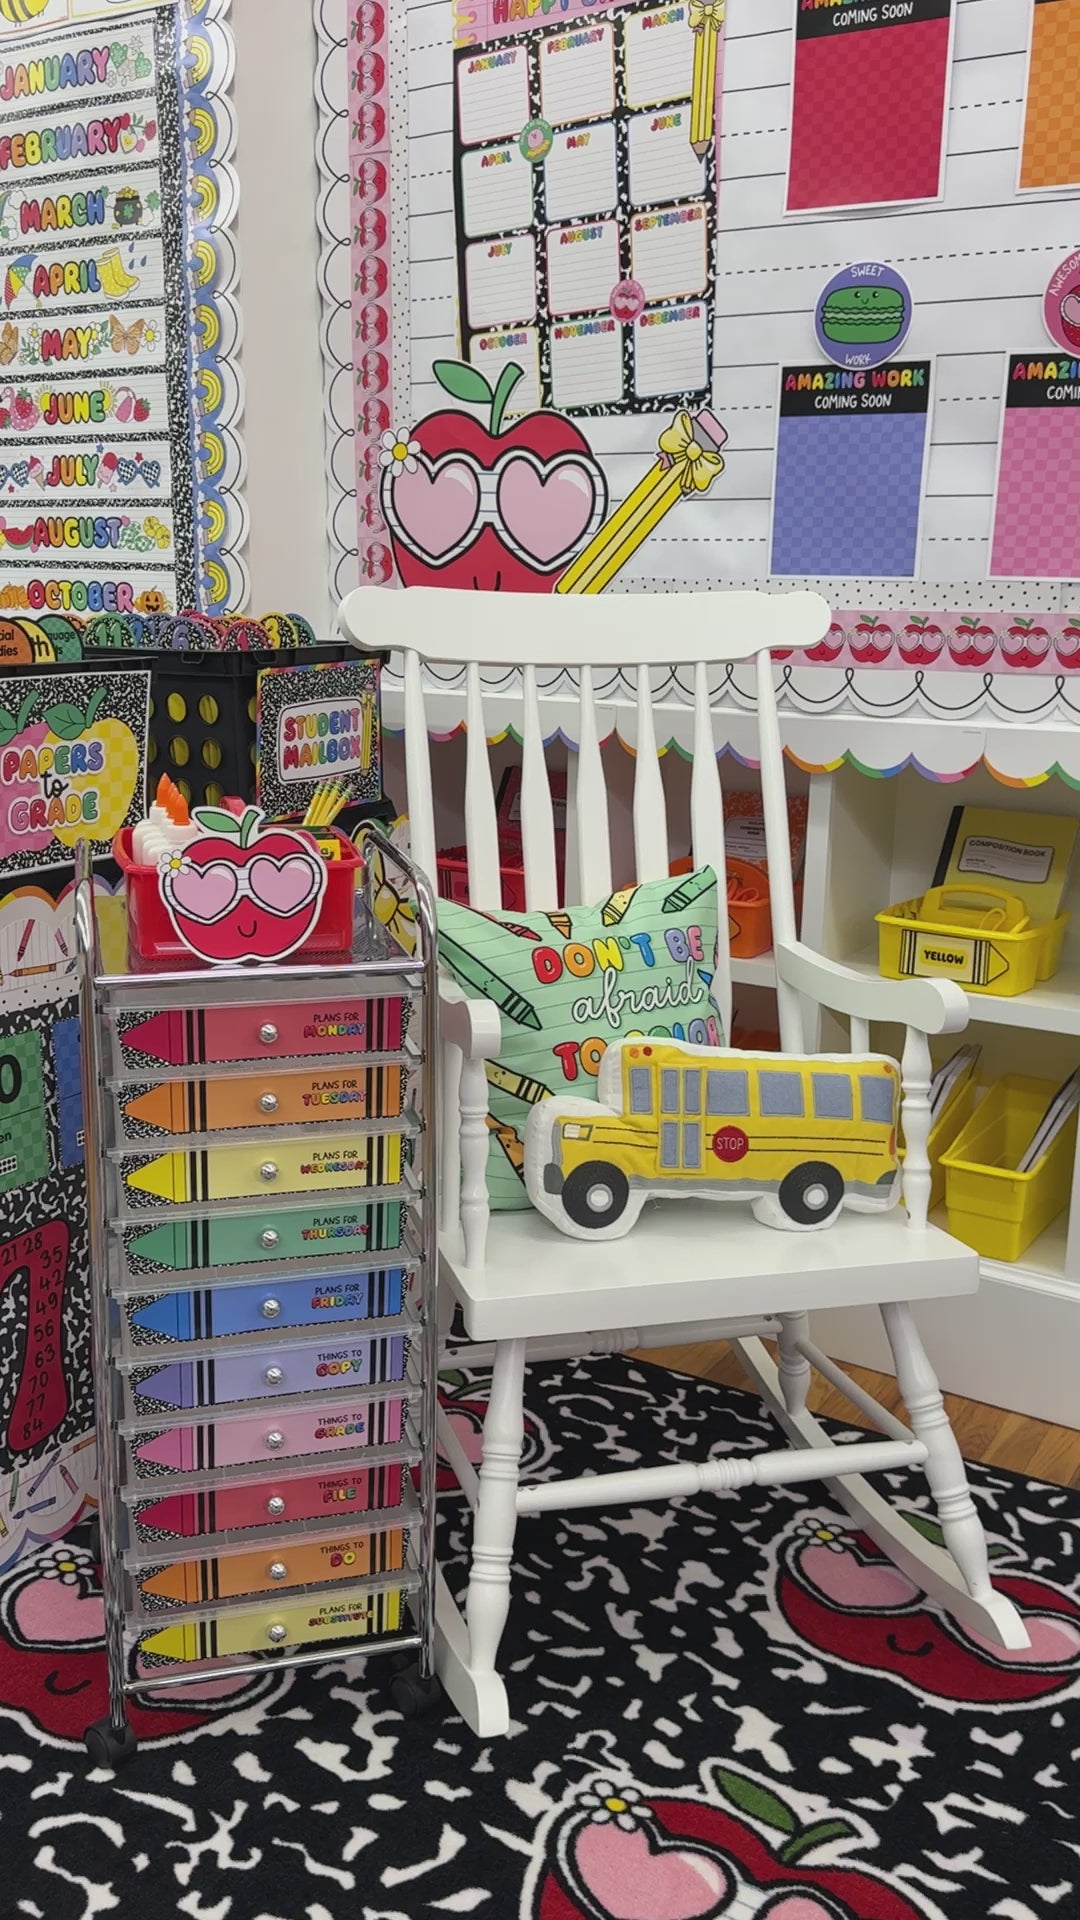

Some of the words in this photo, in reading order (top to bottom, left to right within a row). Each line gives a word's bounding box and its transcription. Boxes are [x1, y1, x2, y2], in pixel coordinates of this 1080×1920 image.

[642, 8, 684, 30] MARCH
[833, 8, 877, 26] COMING
[882, 2, 913, 19] SOON
[547, 28, 604, 54] FEBRUARY
[468, 51, 517, 73] JANUARY
[0, 46, 110, 100] JANUARY
[651, 113, 682, 132] JUNE
[0, 117, 121, 170] FEBRUARY
[566, 132, 590, 149] MAY
[481, 150, 512, 168] APRIL
[20, 190, 104, 234] MARCH
[634, 208, 702, 231] SEPTEMBER
[560, 226, 603, 245] AUGUST
[488, 242, 512, 258] JULY
[33, 259, 100, 297] APRIL
[851, 265, 885, 278] SWEET
[1049, 254, 1080, 296] AWESOM
[640, 306, 700, 328] DECEMBER
[554, 319, 615, 339] NOVEMBER
[41, 327, 91, 361] MAY
[479, 333, 527, 351] OCTOBER
[845, 353, 871, 366] WORK
[785, 371, 865, 391] AMAZING
[871, 368, 925, 388] WORK
[1012, 361, 1080, 380] AMAZI
[815, 394, 857, 410] COMING
[861, 394, 892, 408] SOON
[1046, 384, 1080, 400] COMI
[44, 391, 105, 424] JUNE
[47, 454, 98, 487] JULY
[33, 516, 122, 548] AUGUST
[27, 580, 134, 613] OCTOBER
[284, 708, 360, 741] STUDENT
[3, 741, 104, 781] PAPERS
[284, 735, 360, 770] MAILBOX
[41, 770, 69, 798] to
[11, 791, 98, 831] GRADE
[969, 840, 1022, 854] COMPOSITION
[1023, 849, 1046, 857] BOOK
[531, 932, 655, 984] DON'T
[664, 925, 704, 963] BE
[924, 950, 964, 965] YELLOW
[572, 955, 703, 1029] afraid
[314, 1013, 341, 1022] PLANS
[344, 1012, 359, 1021] FOR
[303, 1023, 366, 1038] MONDAY
[553, 1037, 608, 1081] TO
[0, 1054, 22, 1104] 0
[312, 1081, 340, 1091] PLANS
[342, 1080, 358, 1089] FOR
[302, 1090, 368, 1107] TUESDAY
[716, 1138, 744, 1151] STOP
[313, 1151, 341, 1161] PLANS
[343, 1150, 358, 1159] FOR
[300, 1160, 369, 1175] WEDNESDAY
[313, 1216, 341, 1227] PLANS
[343, 1215, 358, 1224] FOR
[23, 1231, 42, 1255] 28
[302, 1224, 370, 1241] THURSDAY
[41, 1245, 62, 1269] 35
[40, 1269, 63, 1290] 42
[315, 1284, 343, 1295] PLANS
[345, 1283, 360, 1292] FOR
[36, 1292, 58, 1315] 49
[311, 1292, 364, 1310] FRIDAY
[34, 1319, 54, 1342] 56
[35, 1344, 55, 1368] 63
[317, 1351, 349, 1361] THINGS
[351, 1349, 362, 1357] TO
[316, 1359, 362, 1377] COPY
[28, 1371, 49, 1394] 70
[26, 1393, 45, 1418] 77
[23, 1418, 43, 1441] 84
[318, 1414, 349, 1425] THINGS
[352, 1413, 362, 1421] TO
[314, 1421, 366, 1439] GRADE
[318, 1479, 348, 1489] THINGS
[352, 1477, 362, 1486] TO
[323, 1487, 357, 1503] FILE
[320, 1543, 350, 1554] THINGS
[353, 1541, 364, 1549] TO
[330, 1551, 356, 1567] DO
[319, 1604, 345, 1615] PLANS
[349, 1602, 363, 1611] FOR
